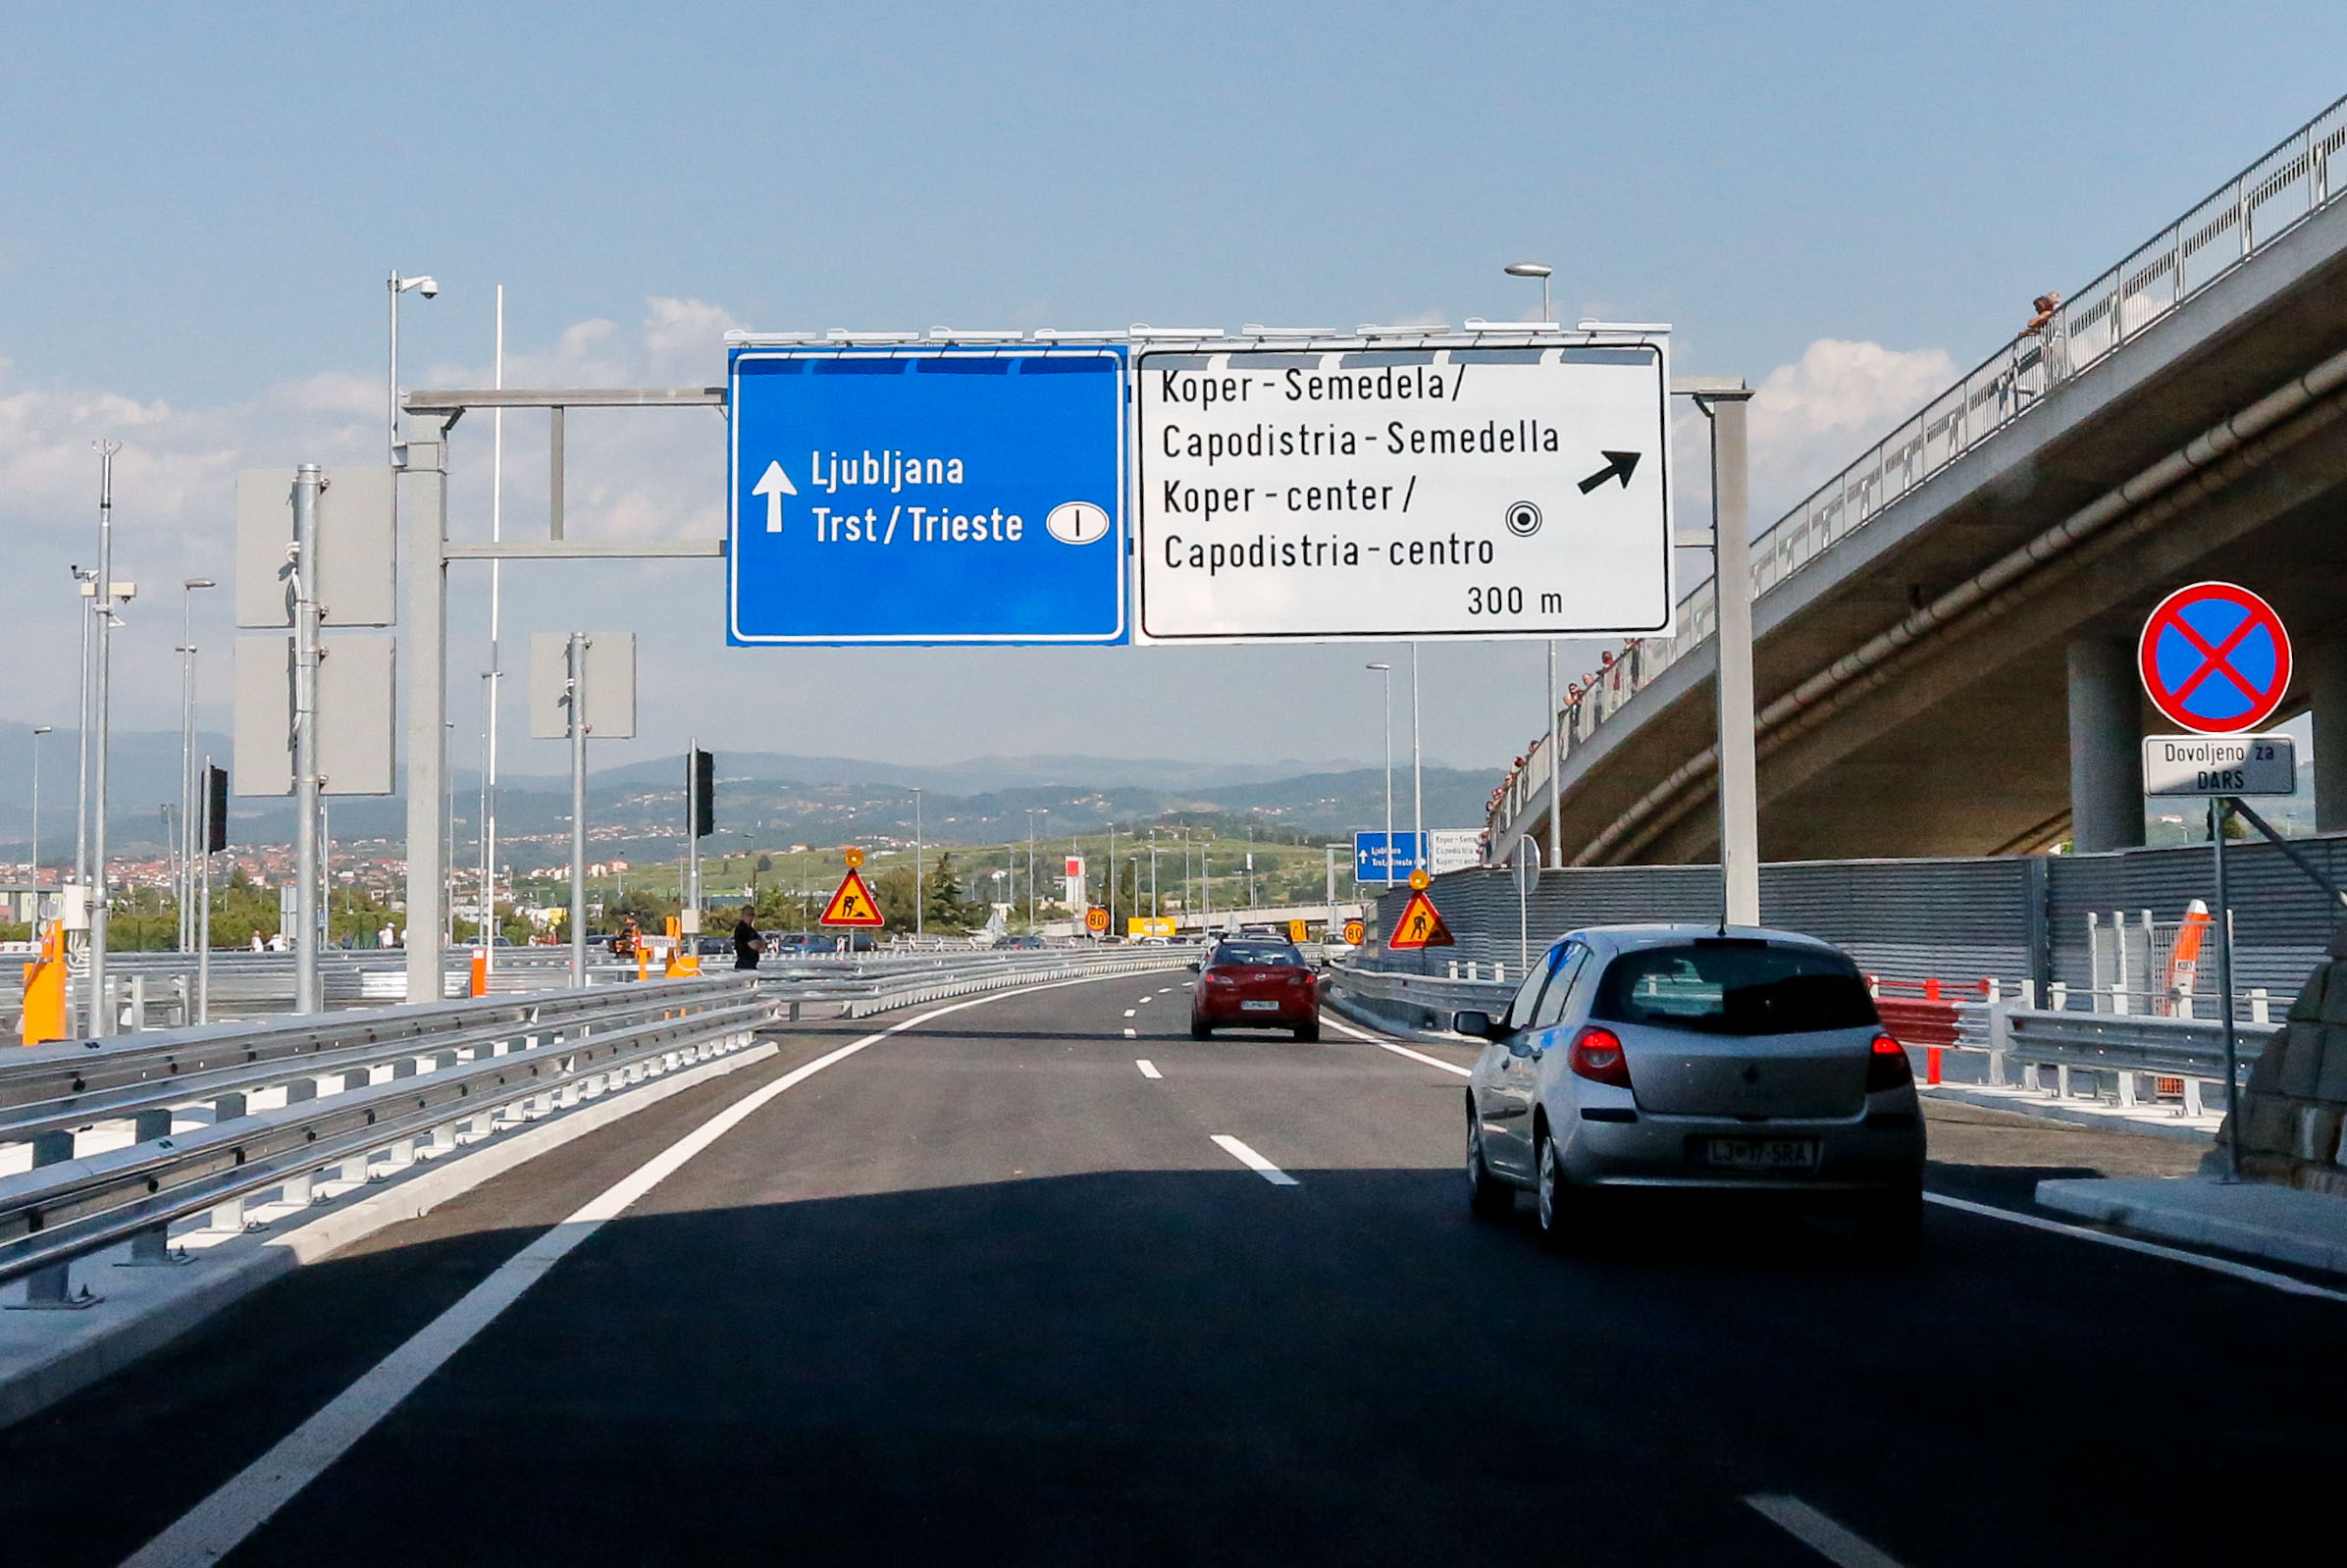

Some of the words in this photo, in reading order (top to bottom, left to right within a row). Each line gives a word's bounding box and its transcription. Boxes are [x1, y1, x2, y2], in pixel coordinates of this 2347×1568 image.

[811, 449, 964, 494] Ljubljana
[1468, 586, 1523, 615] 300
[1540, 593, 1562, 614] m
[2164, 743, 2245, 766] Dovoljeno
[2255, 746, 2275, 761] za
[2197, 770, 2245, 791] DARS
[1089, 914, 1105, 926] 80
[1348, 927, 1363, 940] 80
